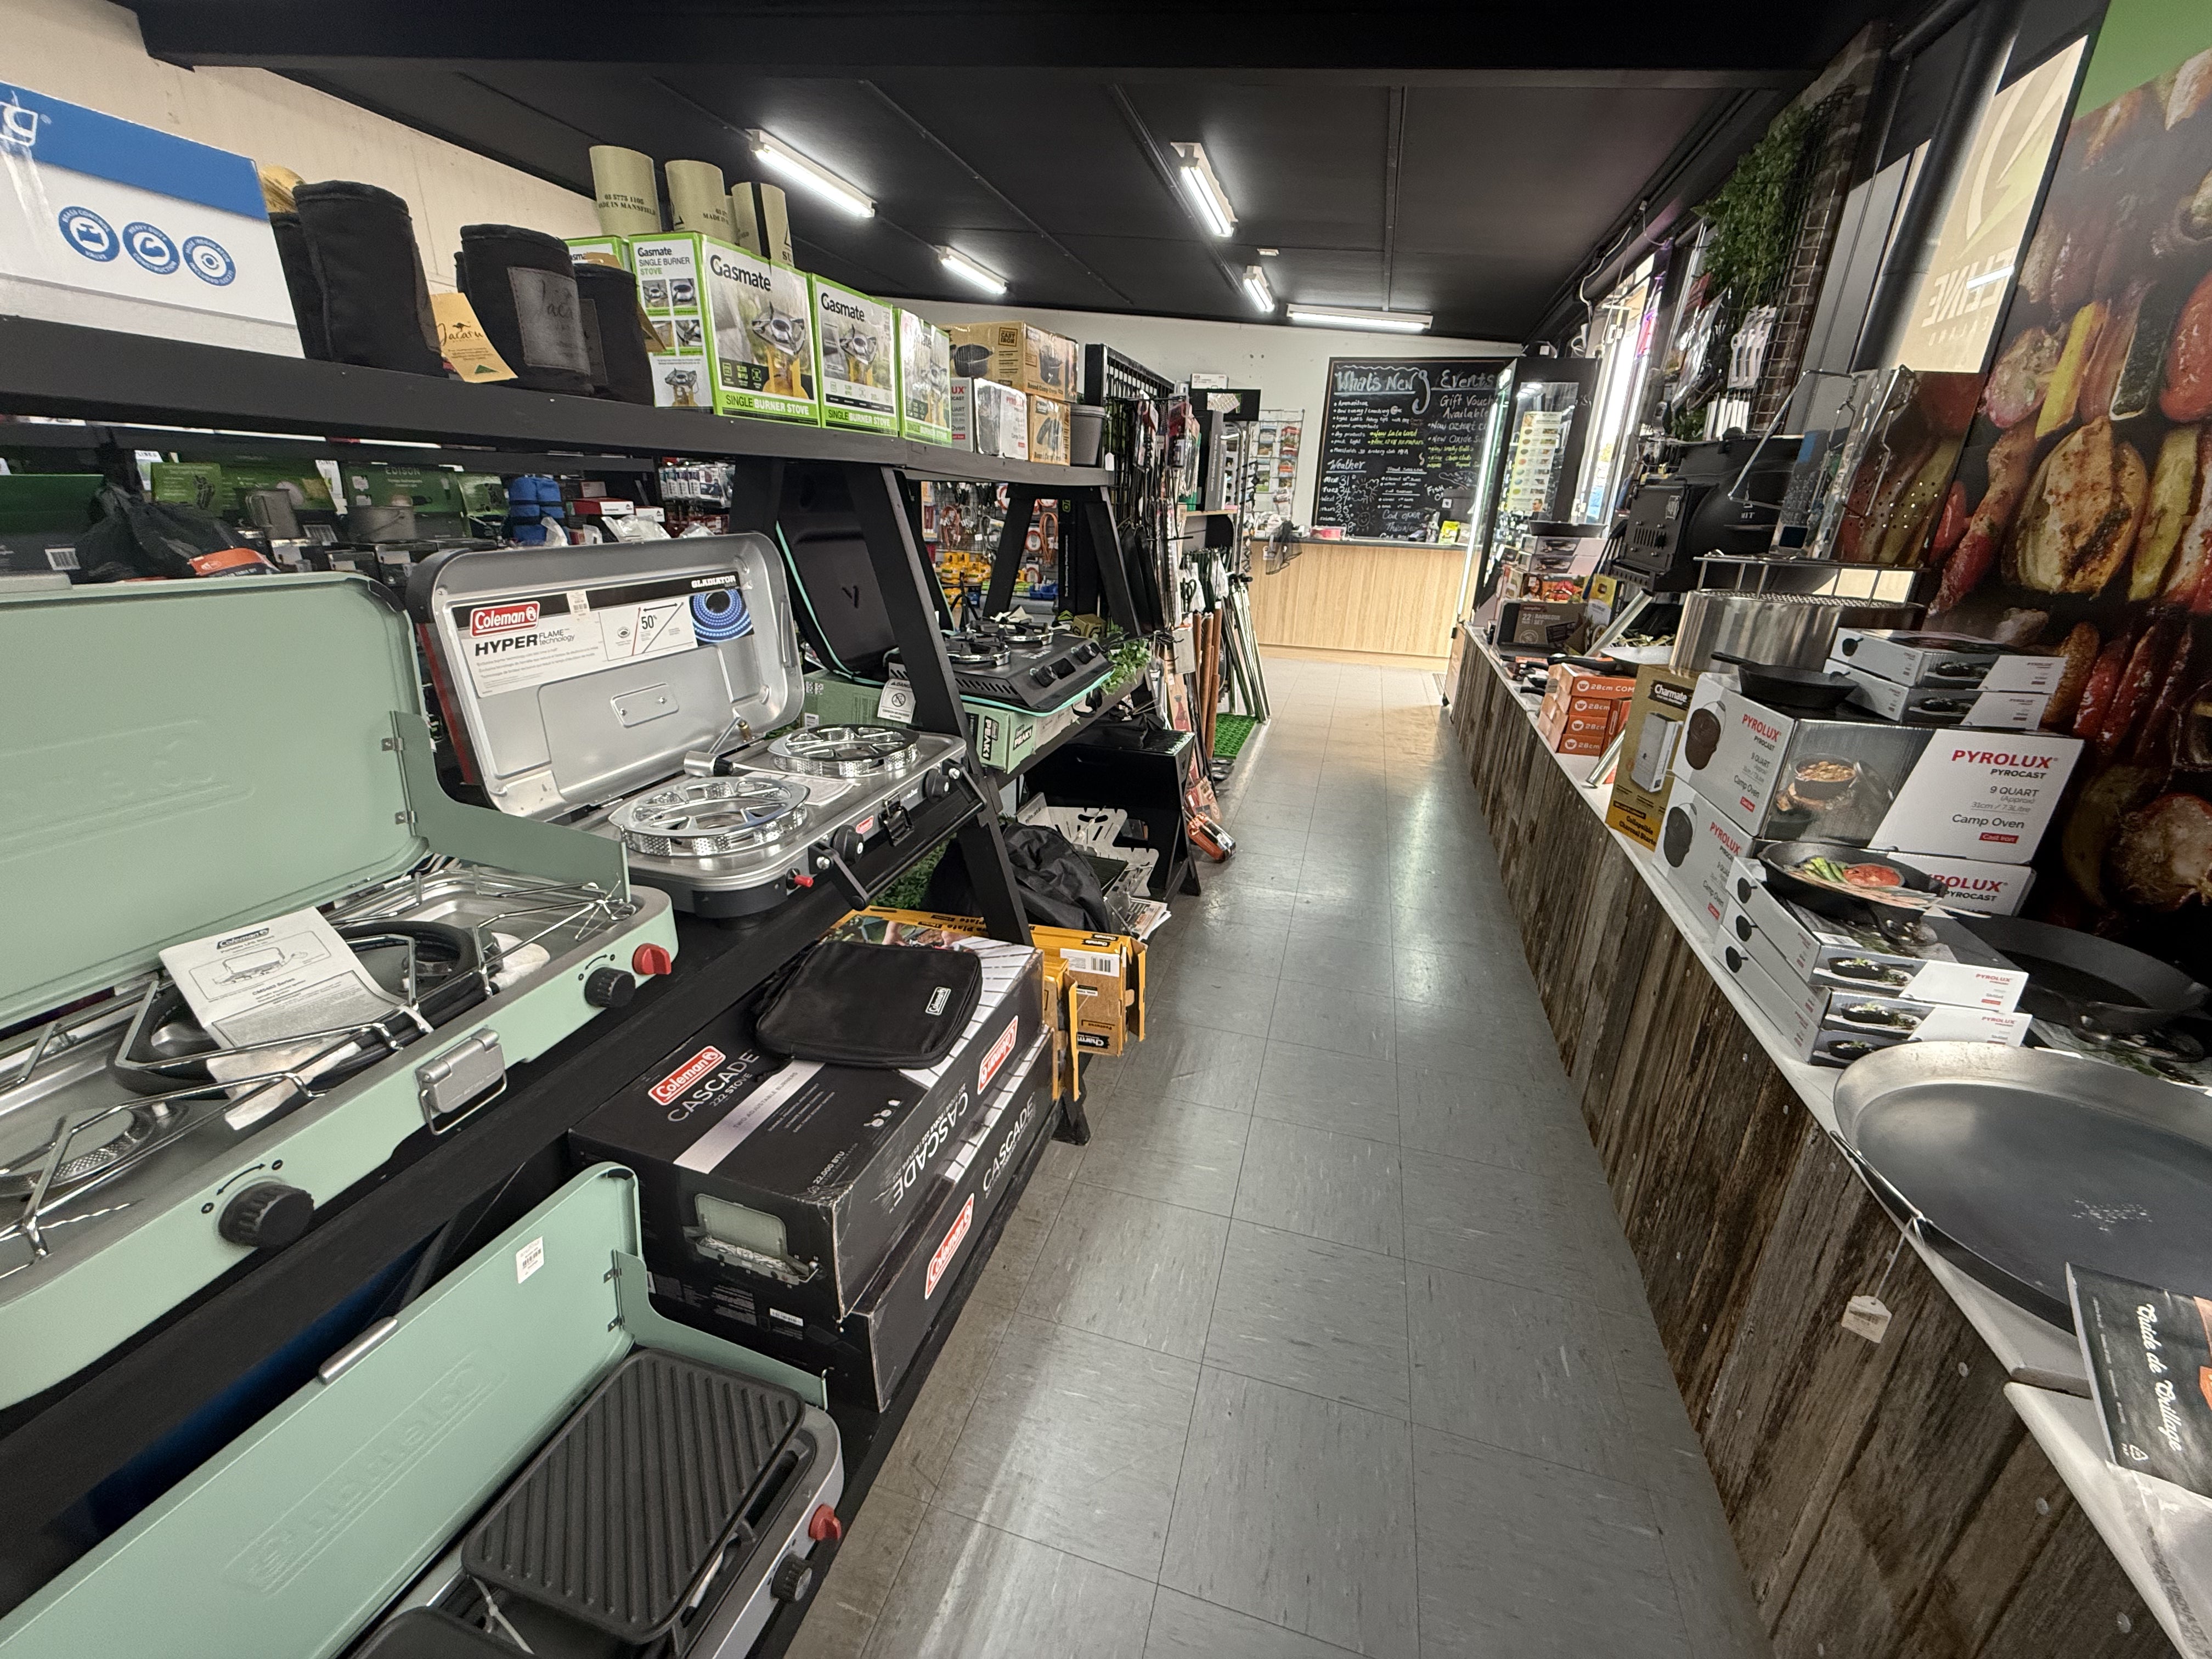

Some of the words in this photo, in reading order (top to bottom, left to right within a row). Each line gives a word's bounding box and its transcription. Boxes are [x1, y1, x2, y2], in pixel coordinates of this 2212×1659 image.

[620, 202, 656, 215] MANSFIELD
[703, 213, 720, 221] MADE
[638, 247, 672, 257] Gasmate
[639, 258, 662, 267] SINGLE
[663, 257, 690, 266] BURNER
[710, 255, 771, 291] Gasmate
[821, 292, 865, 322] Gasmate
[438, 323, 483, 346] Jacaru
[1440, 369, 1495, 388] Events
[726, 394, 753, 408] SINGLE
[754, 398, 786, 412] BURNER
[787, 403, 809, 415] STOVE
[1440, 393, 1463, 409] Gift
[828, 410, 848, 421] SINGLE
[849, 413, 872, 424] BURNER
[873, 417, 890, 427] STOVE
[1443, 408, 1489, 420] Available
[385, 466, 421, 476] EDISON
[1327, 459, 1366, 470] Weather
[1427, 484, 1445, 496] FISH
[691, 575, 736, 589] GLADIATOR
[475, 611, 525, 630] Coleman
[475, 634, 538, 657] HYPER
[539, 629, 564, 639] FLAME
[539, 634, 575, 646] technology
[1590, 684, 1613, 692] 28cm
[1655, 684, 1688, 702] Charmate
[1742, 714, 1779, 742] PYROLUX
[1754, 735, 1775, 752] PYROCAST
[1951, 749, 2053, 769] PYROLUX
[1990, 768, 2046, 779] PYROCAST
[1734, 775, 1748, 791] Camp
[1746, 783, 1760, 799] Oven
[1999, 787, 2039, 797] QUART
[1952, 814, 1989, 828] Camp
[1991, 817, 2025, 830] Oven
[1710, 821, 1740, 855] PYROLUX
[1930, 874, 2004, 893] ROLUX
[219, 932, 259, 947] Coleman
[1976, 973, 2010, 982] PYROLUX
[928, 992, 946, 1013] Coleman
[1982, 1016, 2015, 1024] PYROLUX
[1077, 1036, 1104, 1046] Charm
[656, 1057, 707, 1097] Coleman
[667, 1050, 760, 1122] CASCADE
[710, 1093, 725, 1107] 222
[725, 1072, 753, 1095] STOVE
[733, 1116, 748, 1129] TWO
[747, 1091, 777, 1118] ADJUSTABLE
[776, 1071, 798, 1092] BURNERS
[893, 1092, 969, 1206] CASCADE
[983, 1099, 1035, 1192] CASCADE
[832, 1150, 845, 1165] BTU
[928, 1216, 967, 1283] Coleman
[2136, 1303, 2162, 1351] Guide
[2146, 1351, 2168, 1374] de
